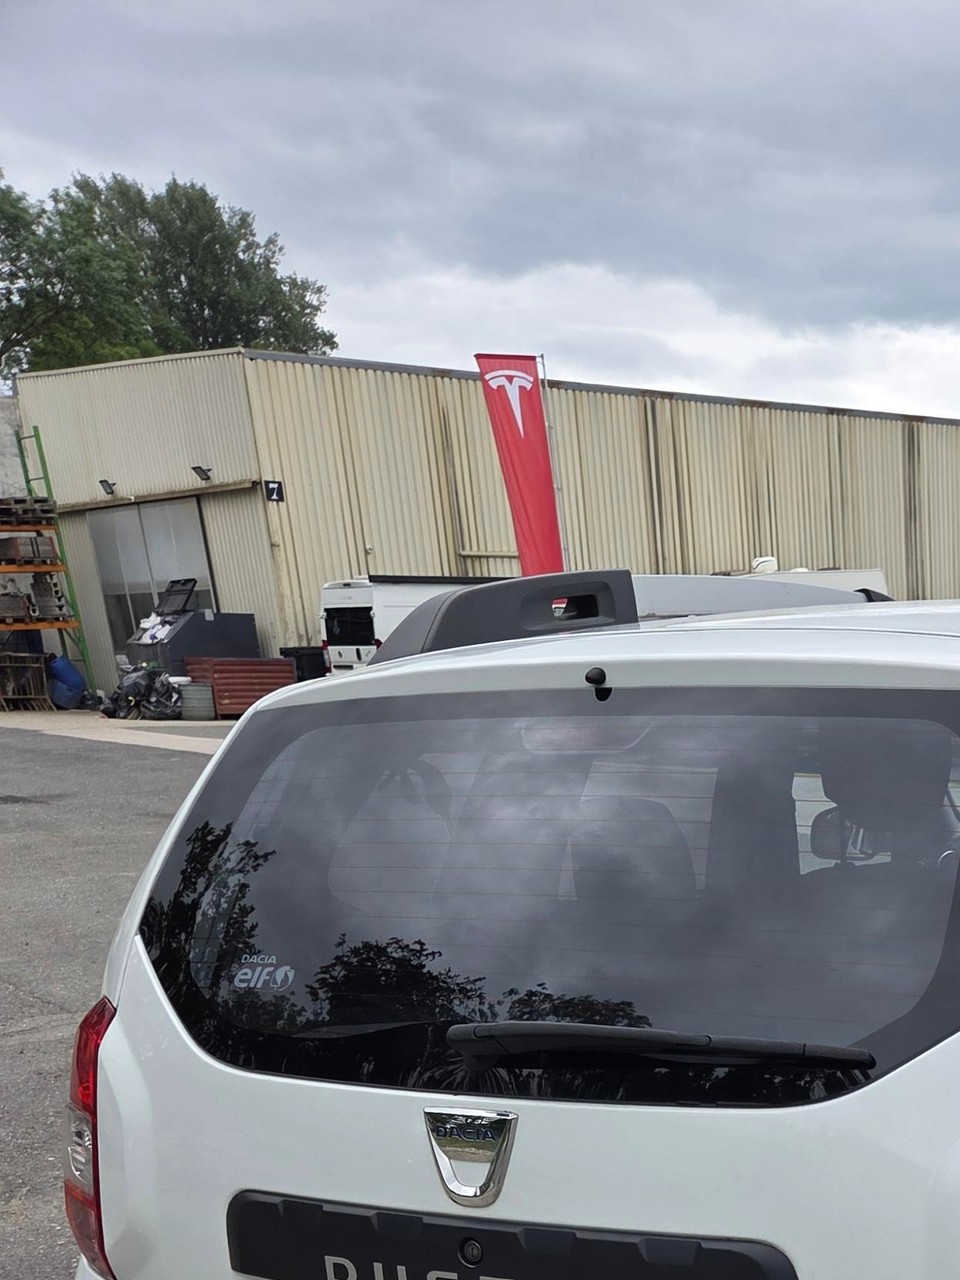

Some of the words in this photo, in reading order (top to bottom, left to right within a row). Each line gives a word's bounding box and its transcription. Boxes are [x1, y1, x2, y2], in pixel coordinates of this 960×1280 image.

[268, 483, 279, 500] 7
[241, 954, 277, 964] DACIA
[234, 966, 274, 988] elf
[436, 1126, 497, 1142] DACIA
